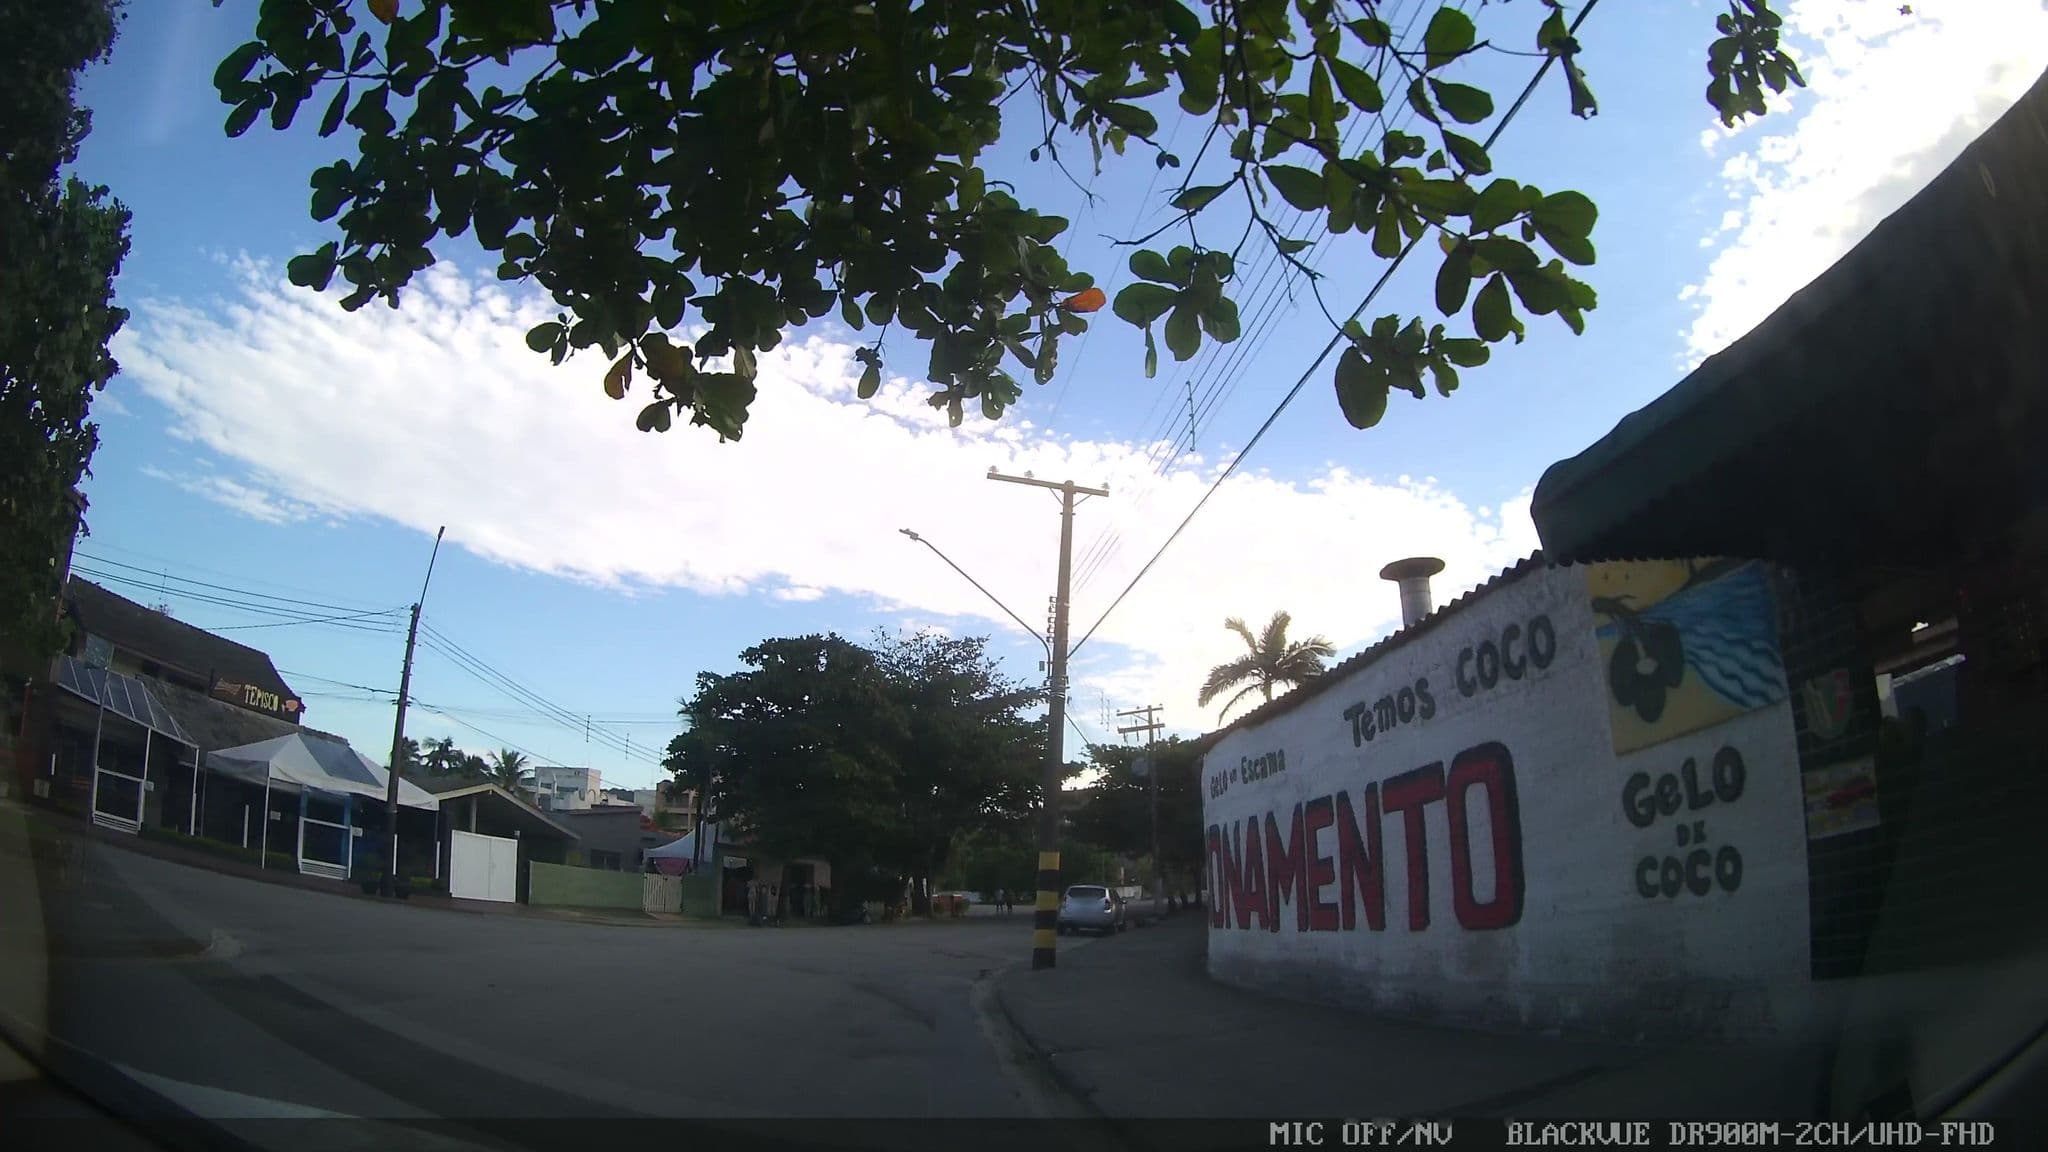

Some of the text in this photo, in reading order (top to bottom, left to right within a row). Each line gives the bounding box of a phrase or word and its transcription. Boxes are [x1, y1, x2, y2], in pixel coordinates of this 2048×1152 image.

[1343, 614, 1557, 748] Temos COCO
[1622, 745, 1746, 829] GeLO
[1635, 844, 1743, 899] COCO
